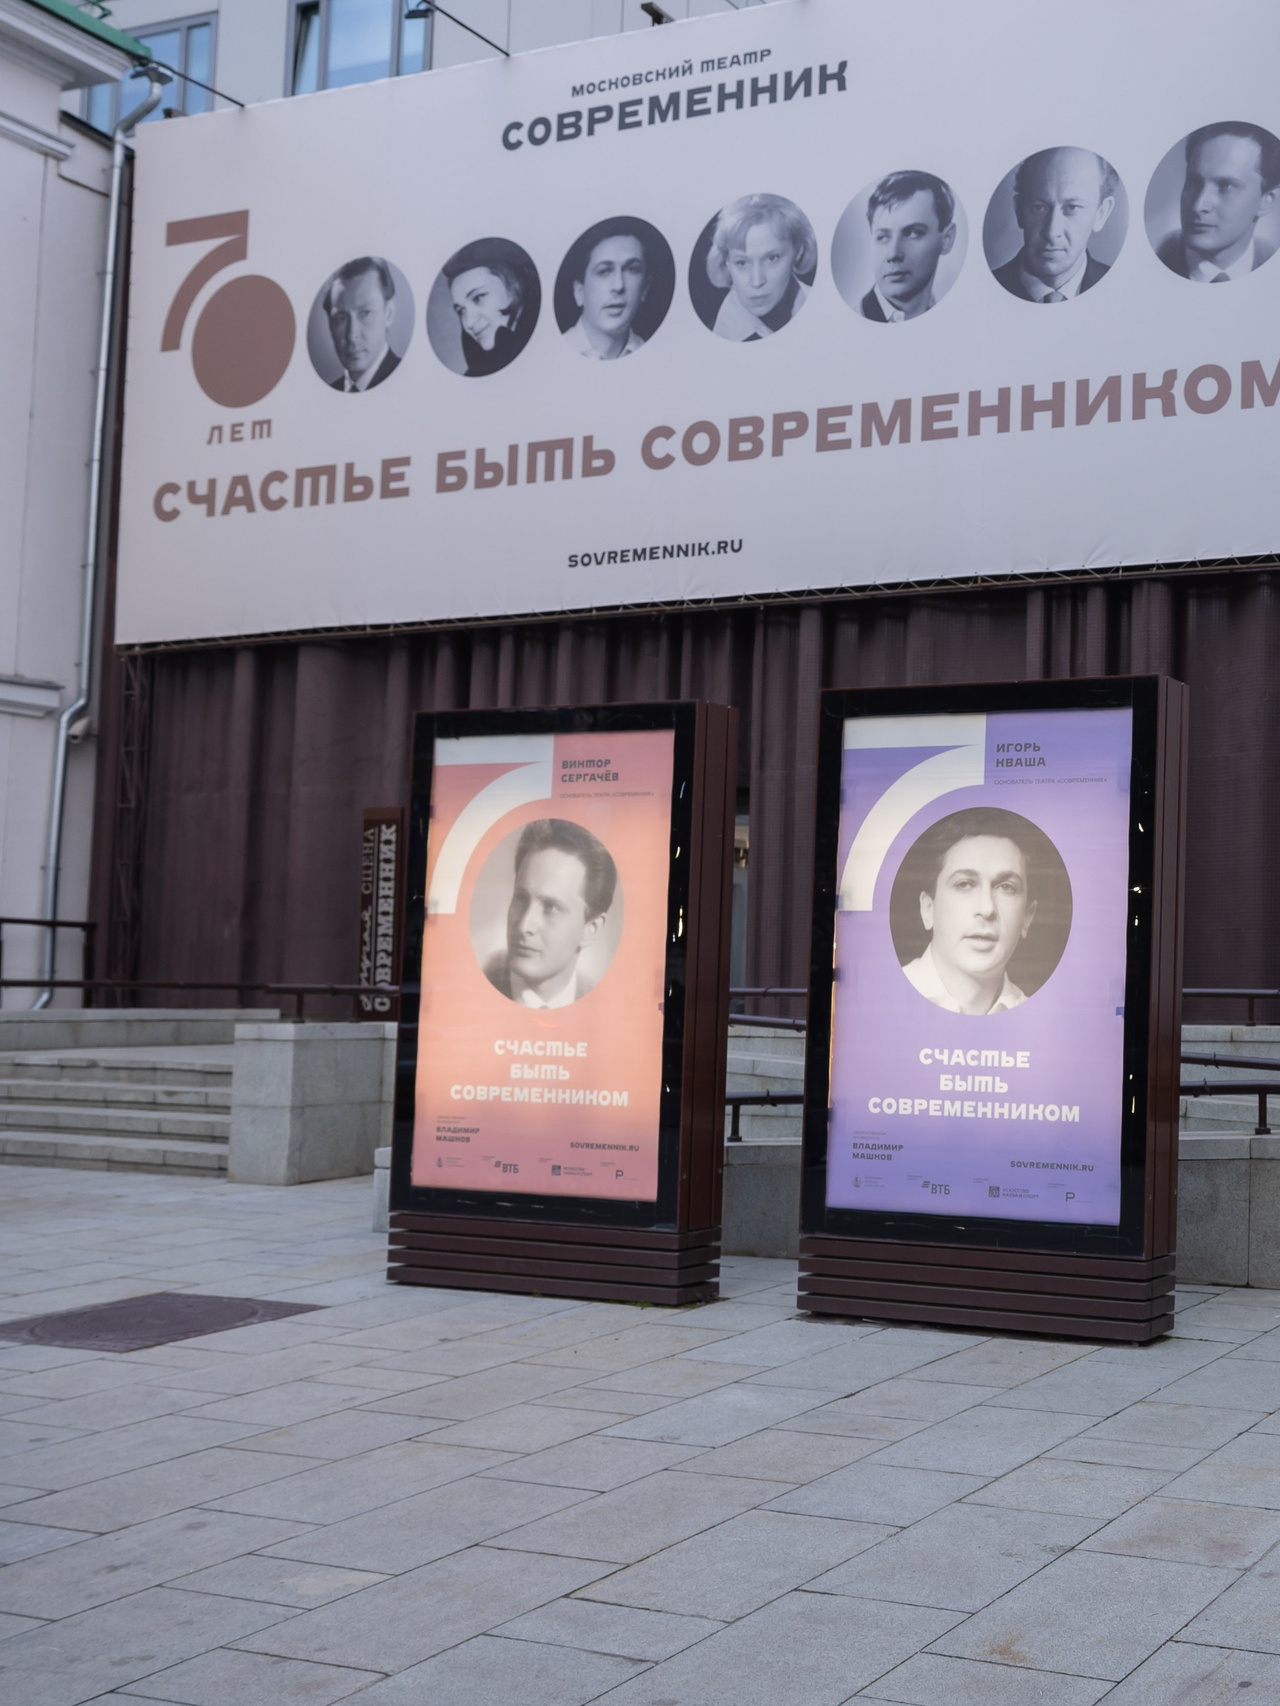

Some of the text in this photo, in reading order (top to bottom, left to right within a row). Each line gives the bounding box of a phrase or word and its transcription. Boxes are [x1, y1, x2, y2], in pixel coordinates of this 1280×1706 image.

[570, 48, 772, 98] МОСКОВСКИЙ ТЕАТР
[500, 60, 849, 152] СОВРЕМЕННИК
[206, 419, 273, 446] ЛЕТ
[152, 456, 411, 523] СЧАСТЬЕ
[434, 434, 616, 495] БЫТЬ
[567, 538, 744, 569] SOVREMENNIK.RU
[996, 742, 1041, 753] ИГОРЬ
[561, 759, 611, 769] ВИКТОР
[995, 757, 1046, 768] КВАША
[561, 770, 619, 783] СЕРГАЧЁВ
[361, 828, 375, 895] СЦЕНА
[493, 1039, 588, 1058] СЧАСТЬЕ
[918, 1048, 1030, 1069] СЧАСТЬЕ
[510, 1063, 570, 1081] БЫТЬ
[939, 1074, 1009, 1094] БЫТЬ
[450, 1084, 629, 1107] СОВРЕМЕННИКОМ
[868, 1097, 1081, 1123] СОВРЕМЕННИКОМ
[436, 1126, 480, 1135] ВЛАДИМИР
[570, 1141, 640, 1152] SOVREMENNIK.RU
[852, 1142, 904, 1152] ВЛАДИМИР
[852, 1152, 893, 1161] МАШКОВ
[502, 1163, 519, 1174] ВТБ
[1010, 1160, 1094, 1172] SOVREMENNIK.RU
[931, 1184, 950, 1195] ВТБ
